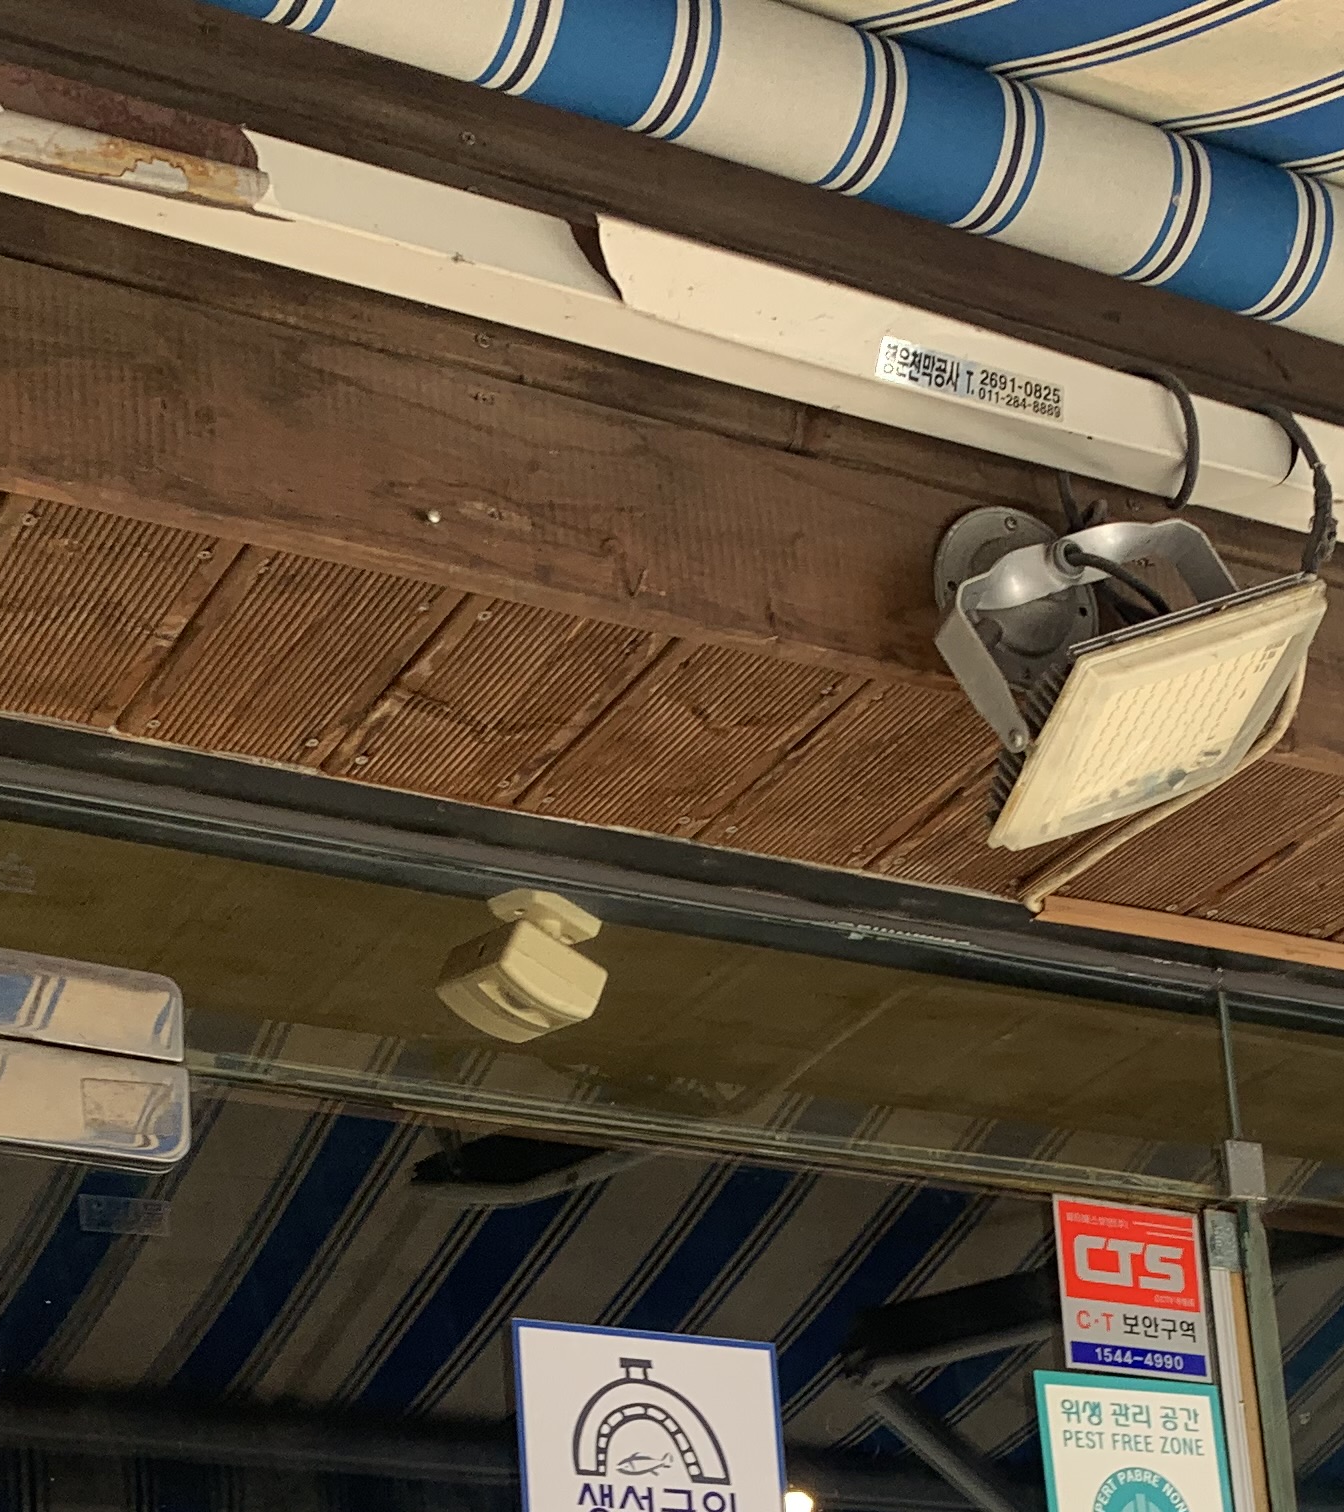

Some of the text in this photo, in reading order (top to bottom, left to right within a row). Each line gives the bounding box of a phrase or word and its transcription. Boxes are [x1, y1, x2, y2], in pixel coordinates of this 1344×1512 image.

[979, 369, 1062, 405] 2691-0825
[1073, 1233, 1186, 1294] CTS
[1122, 1313, 1197, 1344] 보안구역
[1094, 1346, 1185, 1371] 1544-4990
[1060, 1398, 1201, 1433] 위생 관리 공간
[1062, 1429, 1206, 1456] PEST FREE ZONE
[1116, 1468, 1162, 1489] PABRE
